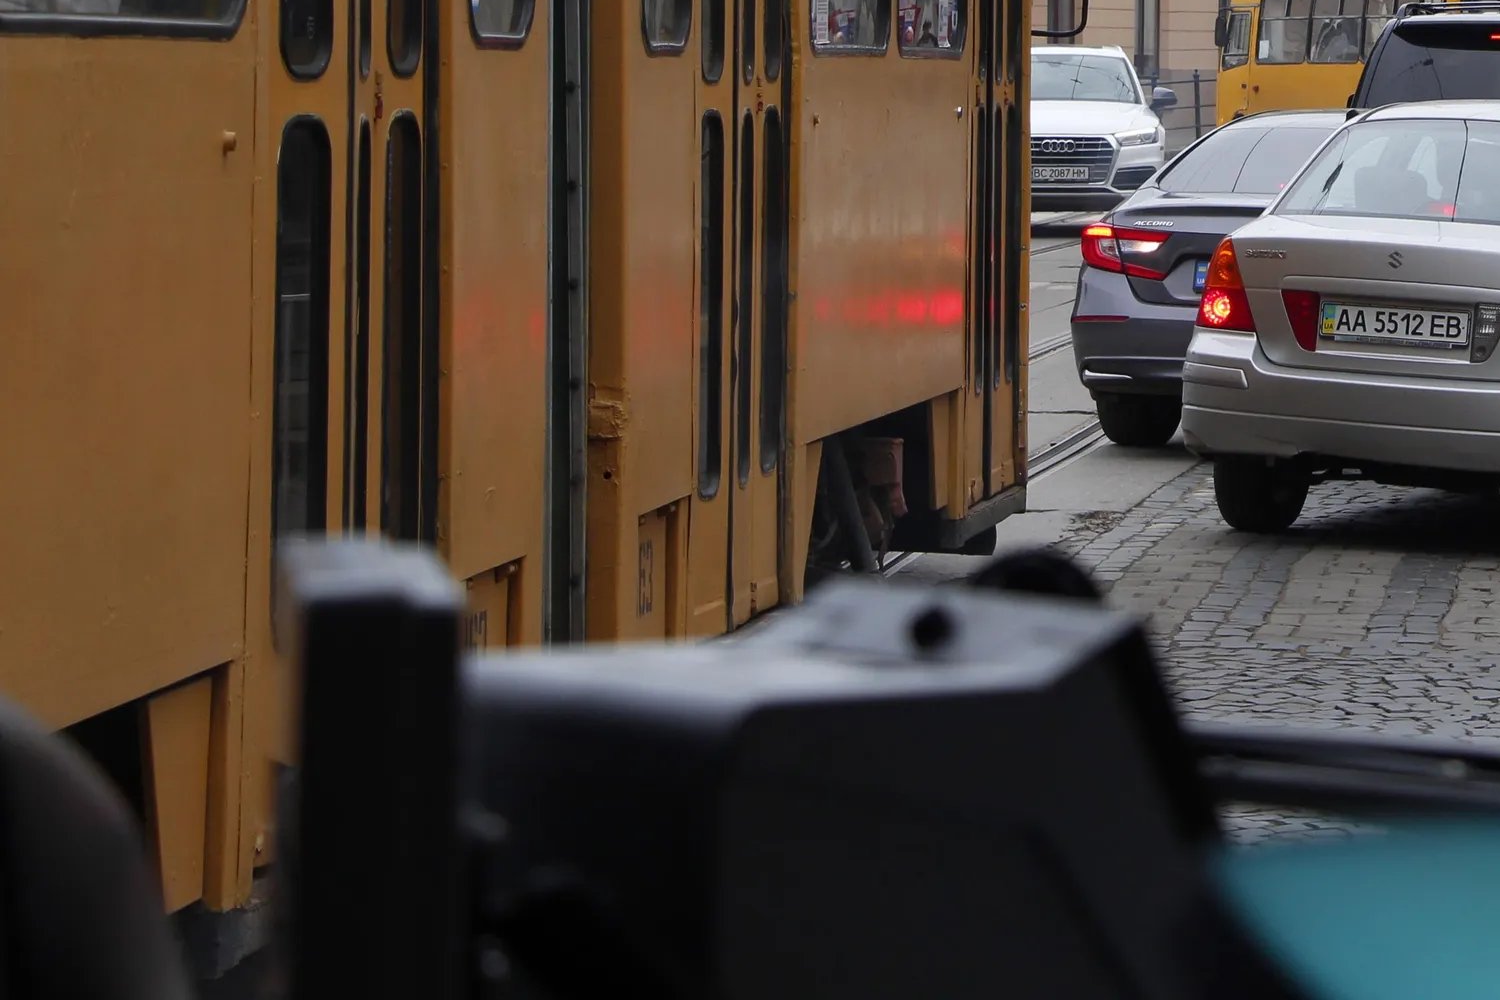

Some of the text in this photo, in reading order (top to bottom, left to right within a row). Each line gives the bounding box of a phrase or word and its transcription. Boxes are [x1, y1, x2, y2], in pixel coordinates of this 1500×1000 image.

[1034, 168, 1047, 178] BC
[1049, 168, 1071, 178] 2087
[1336, 308, 1462, 338] AA 5512 EB
